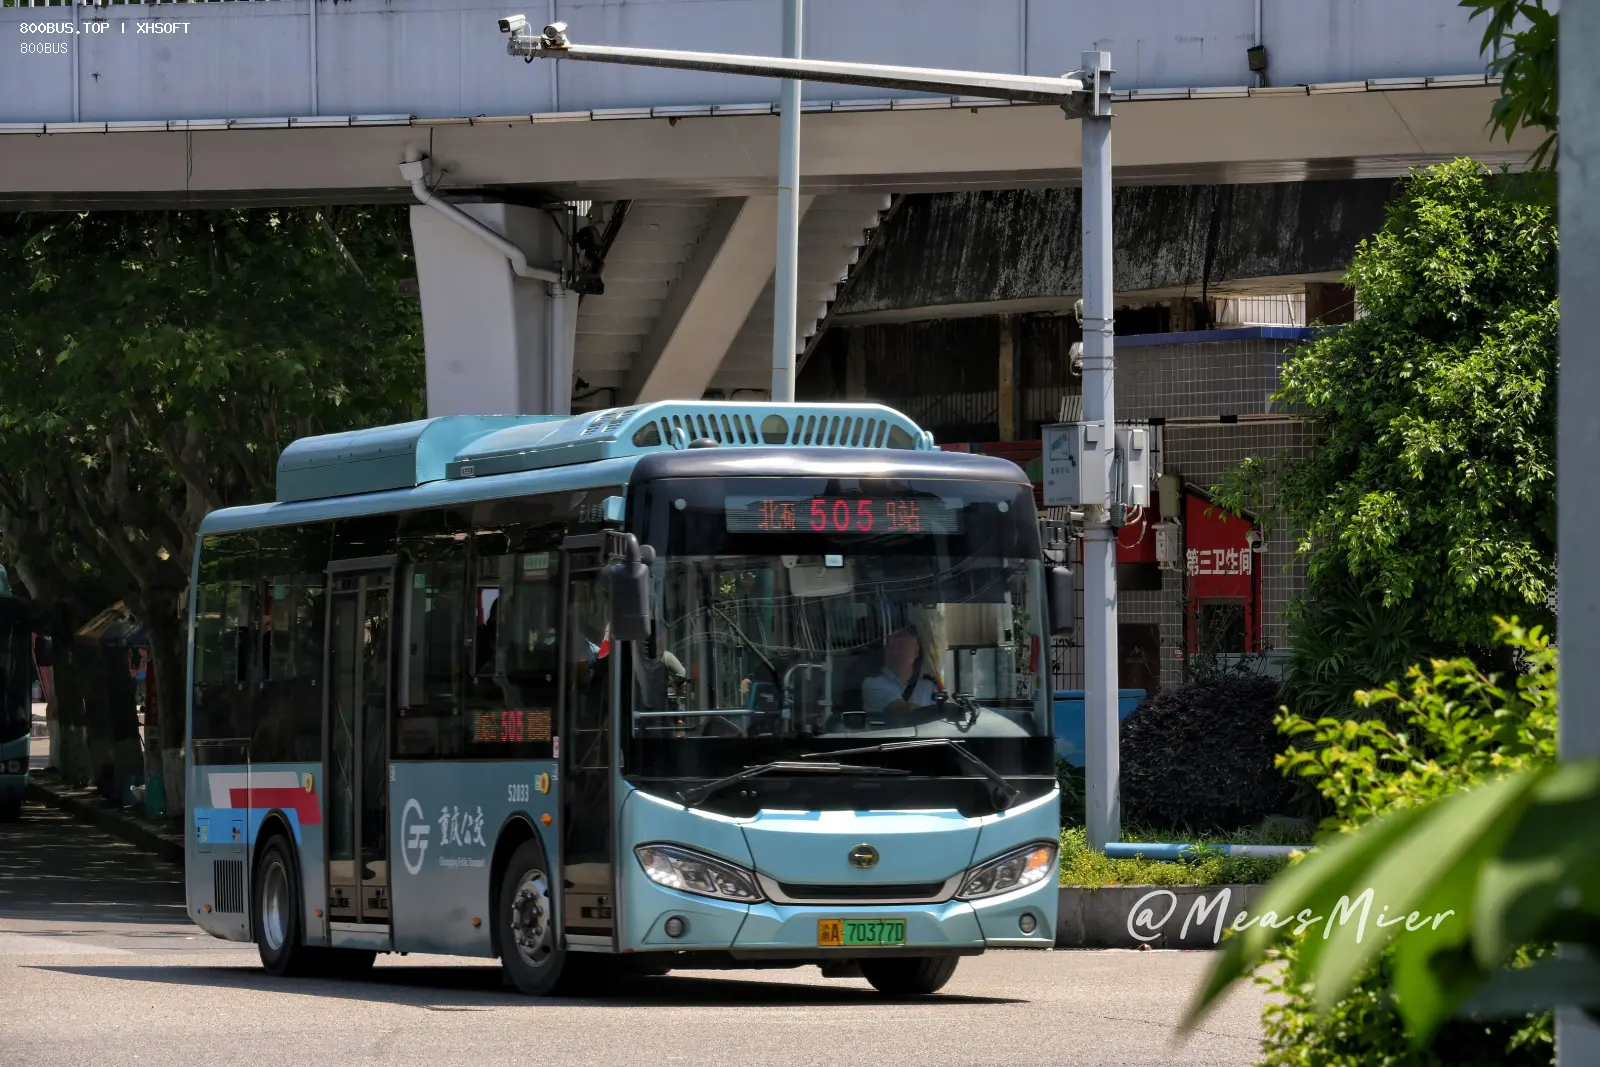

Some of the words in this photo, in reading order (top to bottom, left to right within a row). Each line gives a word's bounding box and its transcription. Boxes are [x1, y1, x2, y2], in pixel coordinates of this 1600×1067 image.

[810, 499, 873, 531] 505
[1186, 548, 1252, 576] 第三卫生间
[501, 711, 524, 742] 505
[507, 784, 529, 802] 52033
